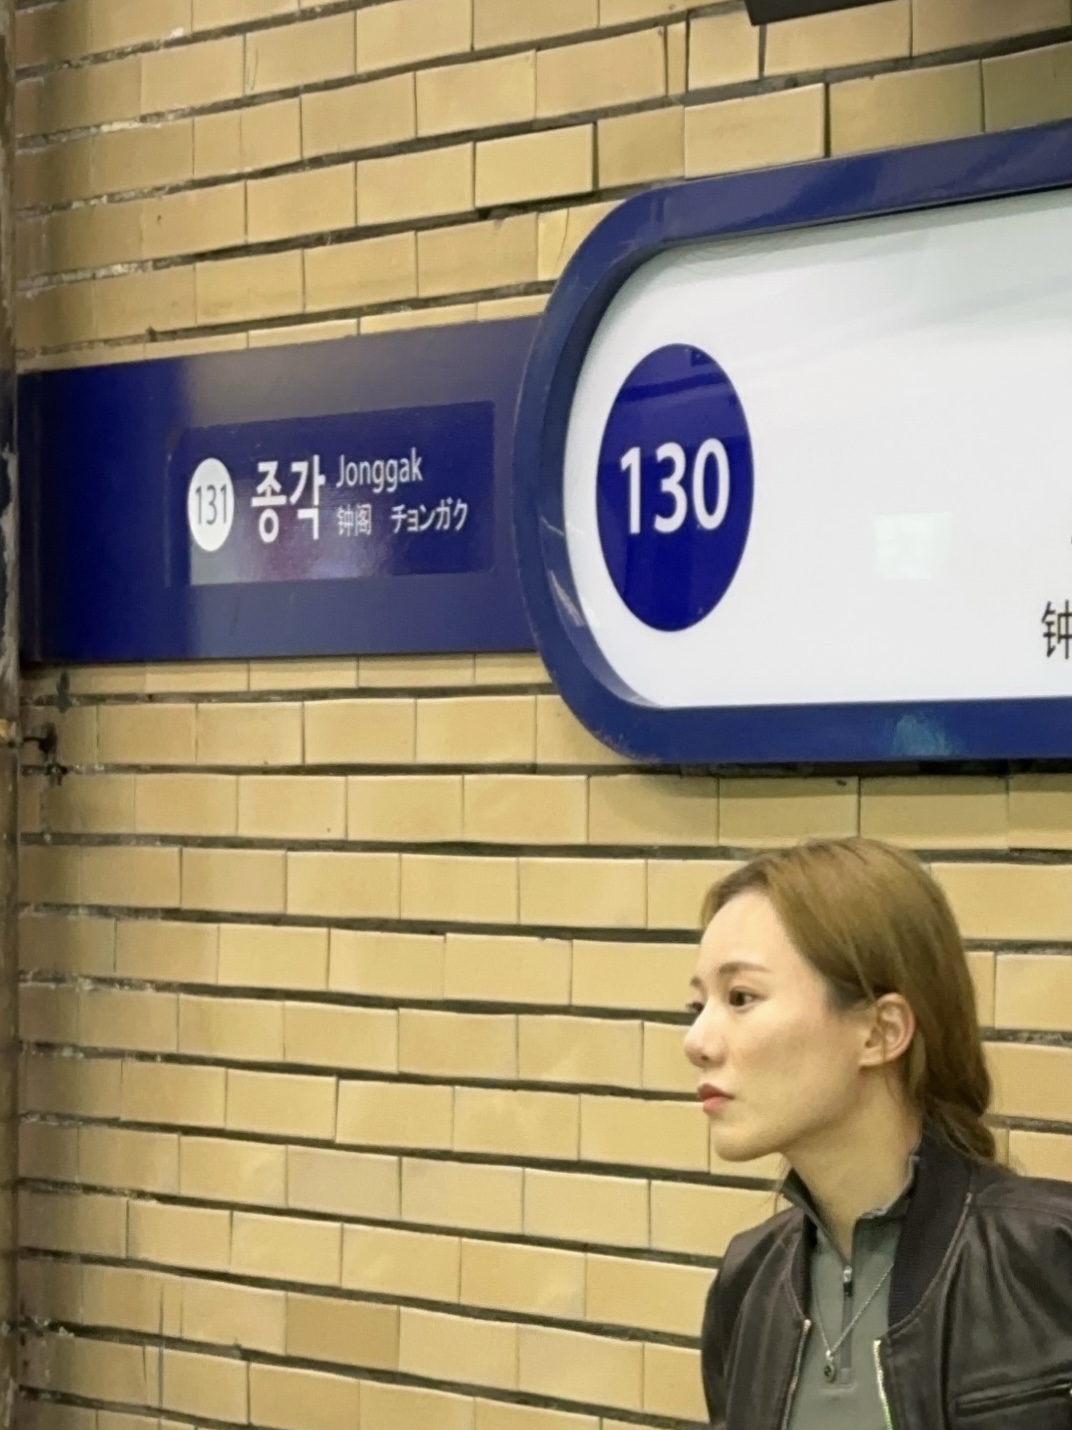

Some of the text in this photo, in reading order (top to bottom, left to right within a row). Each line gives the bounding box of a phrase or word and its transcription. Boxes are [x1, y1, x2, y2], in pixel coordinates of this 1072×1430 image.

[336, 447, 423, 494] Jonggak
[619, 438, 731, 535] 130
[195, 484, 230, 526] 131
[251, 454, 326, 544] 종각
[336, 503, 372, 537] 钟阁
[390, 497, 468, 534] チョンガク
